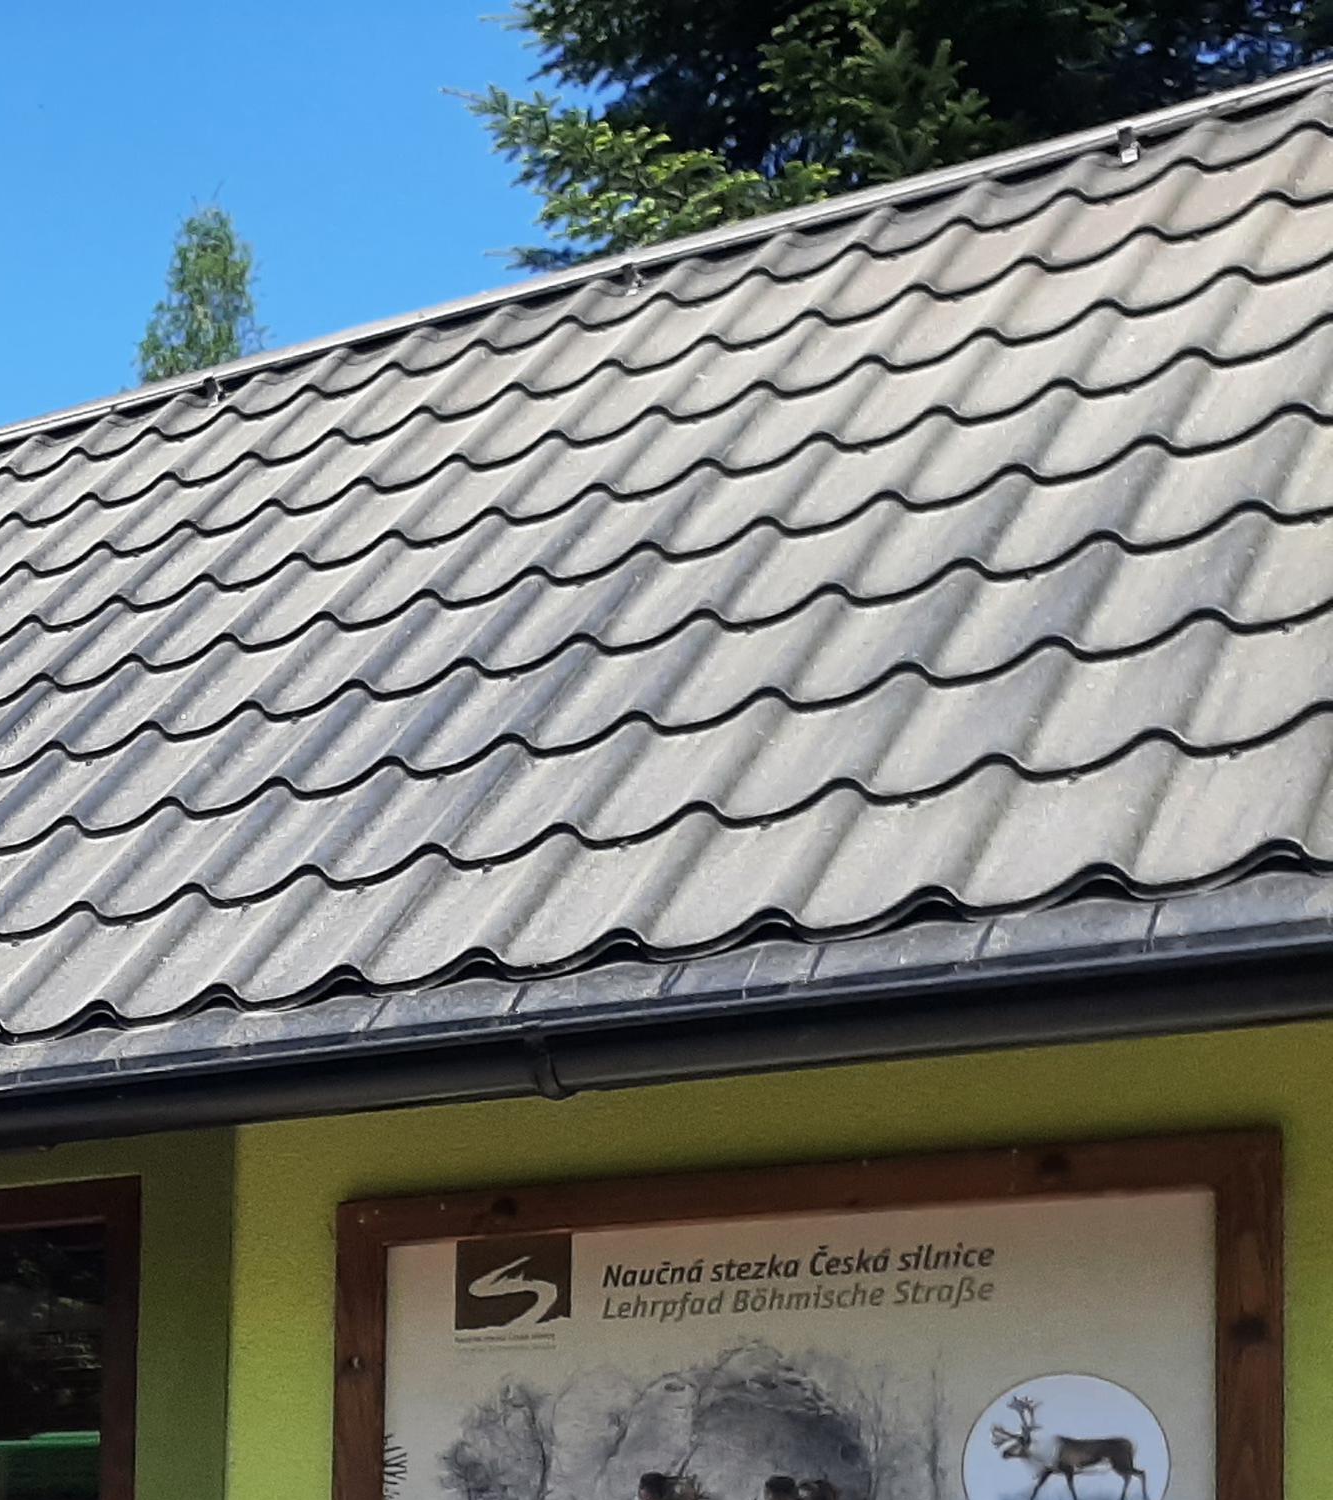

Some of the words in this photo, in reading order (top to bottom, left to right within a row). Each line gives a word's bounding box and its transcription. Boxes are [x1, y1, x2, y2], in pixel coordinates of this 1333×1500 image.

[602, 1258, 704, 1289] Naučná
[710, 1254, 799, 1282] stezka
[809, 1244, 889, 1278] Česká
[897, 1241, 995, 1271] silnice
[601, 1291, 724, 1323] Lehrpfad
[734, 1281, 885, 1314] Böhmische
[892, 1276, 995, 1311] Straße
